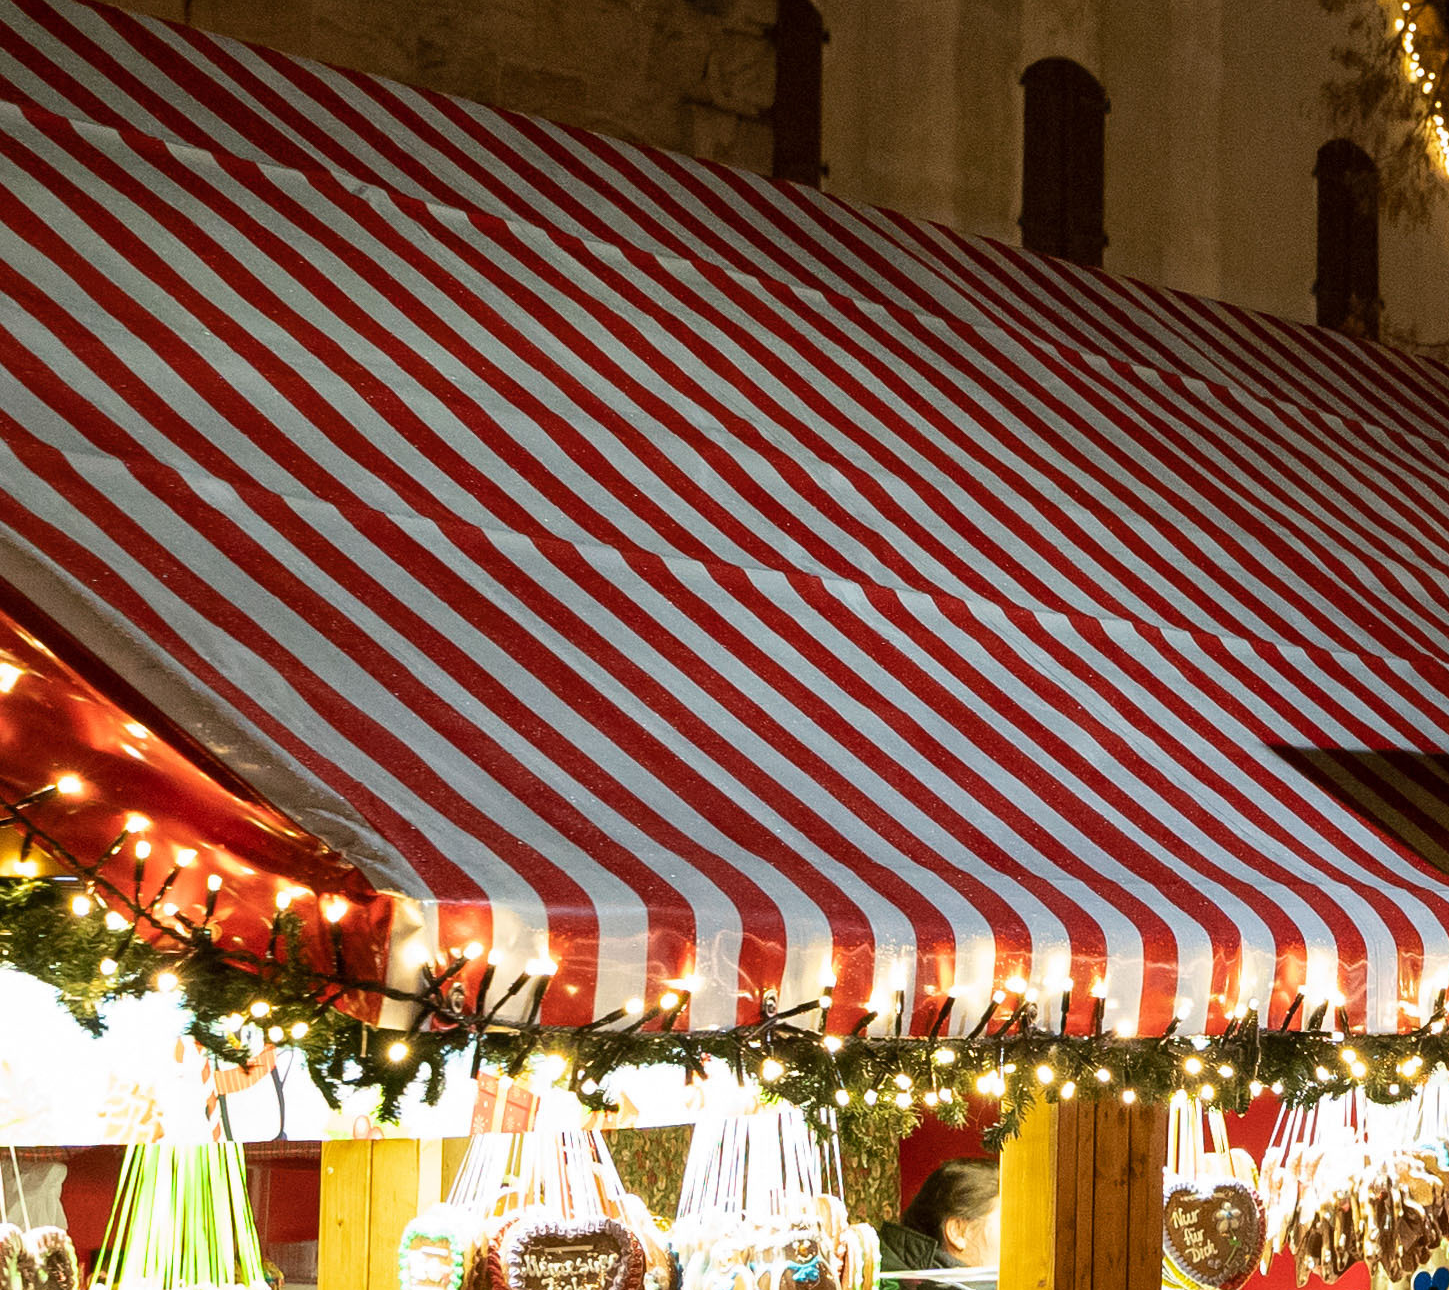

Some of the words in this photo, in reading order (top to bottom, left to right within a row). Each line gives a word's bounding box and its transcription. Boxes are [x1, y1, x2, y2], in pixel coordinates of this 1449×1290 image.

[1171, 1207, 1201, 1229] Nur
[1183, 1227, 1205, 1246] für
[1184, 1239, 1219, 1264] Dich
